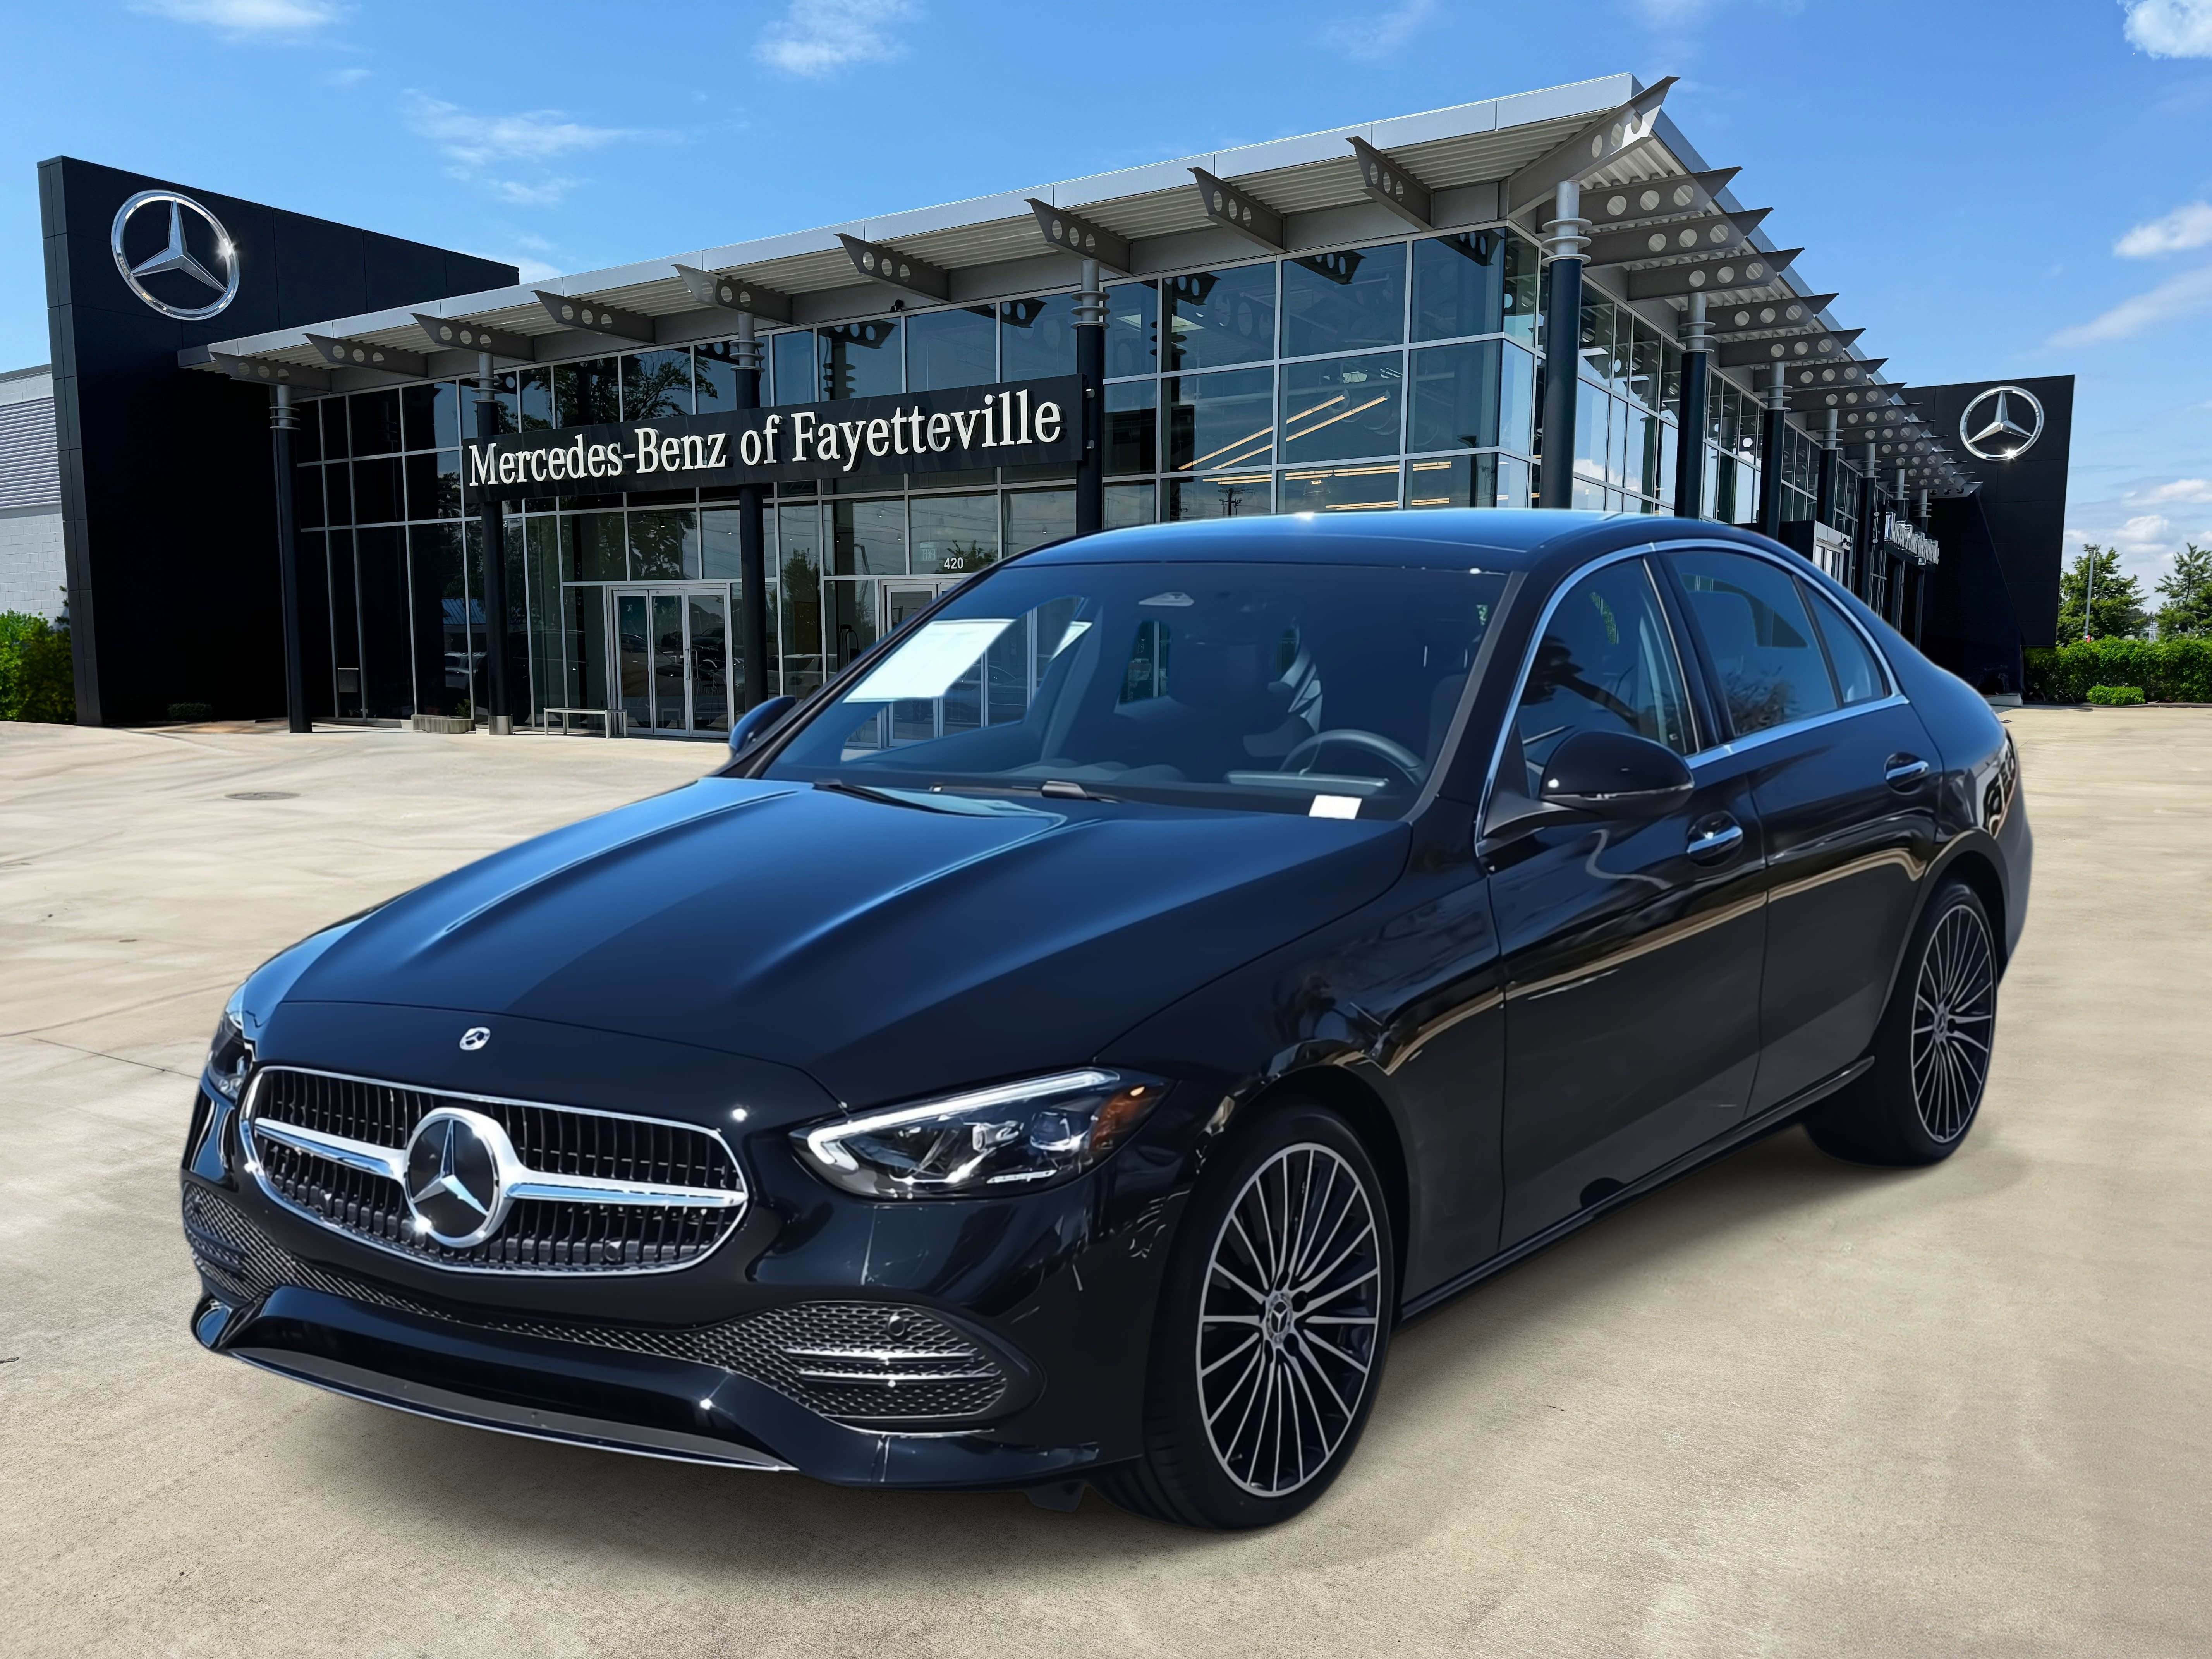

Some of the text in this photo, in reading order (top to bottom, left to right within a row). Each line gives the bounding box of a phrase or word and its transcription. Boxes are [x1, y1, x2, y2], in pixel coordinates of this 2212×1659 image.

[468, 388, 1061, 487] Mercedes-Benz of Fayetteville
[944, 557, 963, 569] 420
